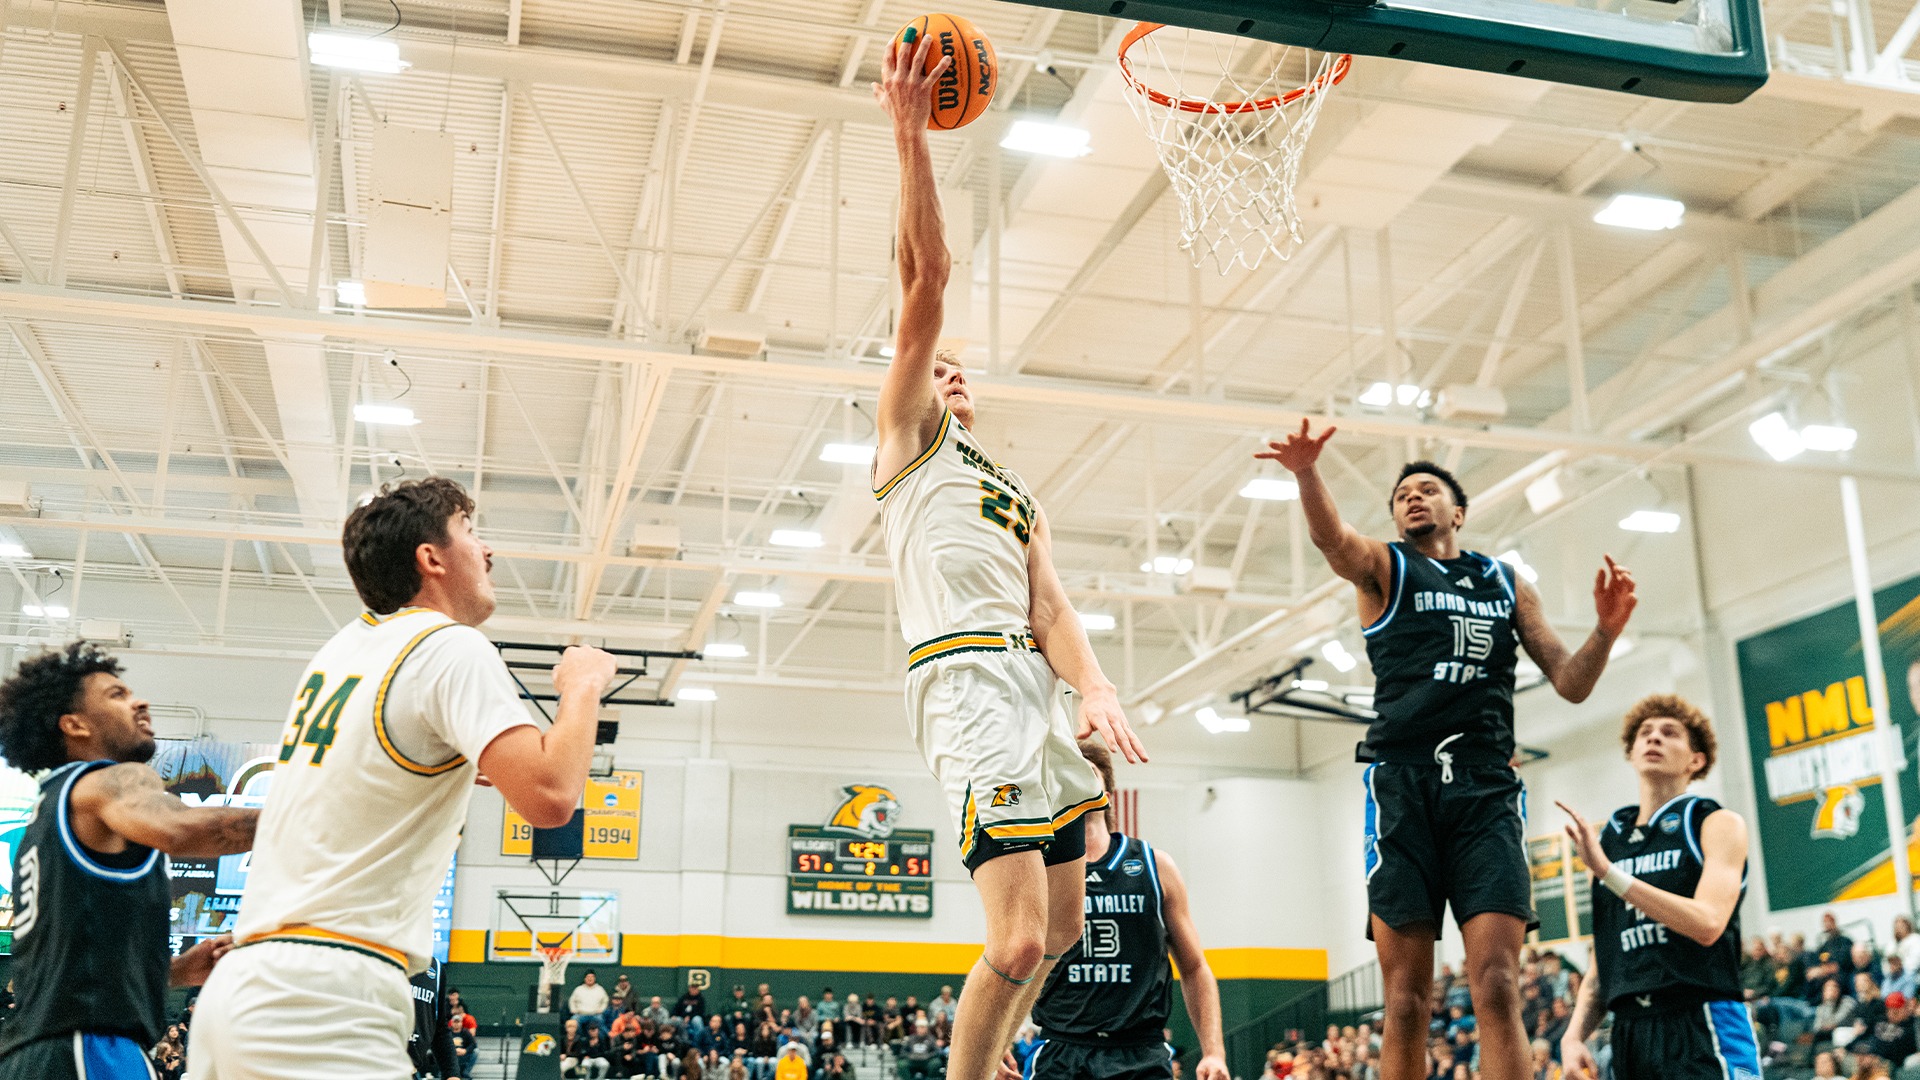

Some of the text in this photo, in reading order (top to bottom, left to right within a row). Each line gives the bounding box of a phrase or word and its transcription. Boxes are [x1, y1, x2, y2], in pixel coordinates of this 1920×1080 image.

[939, 32, 958, 110] Wilson
[974, 40, 990, 95] NCAA
[1414, 591, 1467, 613] GRAND
[1009, 633, 1026, 650] N
[1448, 615, 1495, 661] 15
[278, 671, 364, 768] 34
[511, 824, 532, 840] 19
[589, 827, 632, 844] 1994
[849, 843, 885, 859] 4:24
[799, 854, 820, 871] 57
[907, 858, 929, 875] 51
[1635, 849, 1682, 875] VALLEY
[817, 881, 901, 892] HOME OF THE
[793, 892, 929, 911] WILDCATS
[1096, 895, 1145, 913] VALLEY
[1082, 919, 1121, 959] 13
[1068, 964, 1131, 982] STATE
